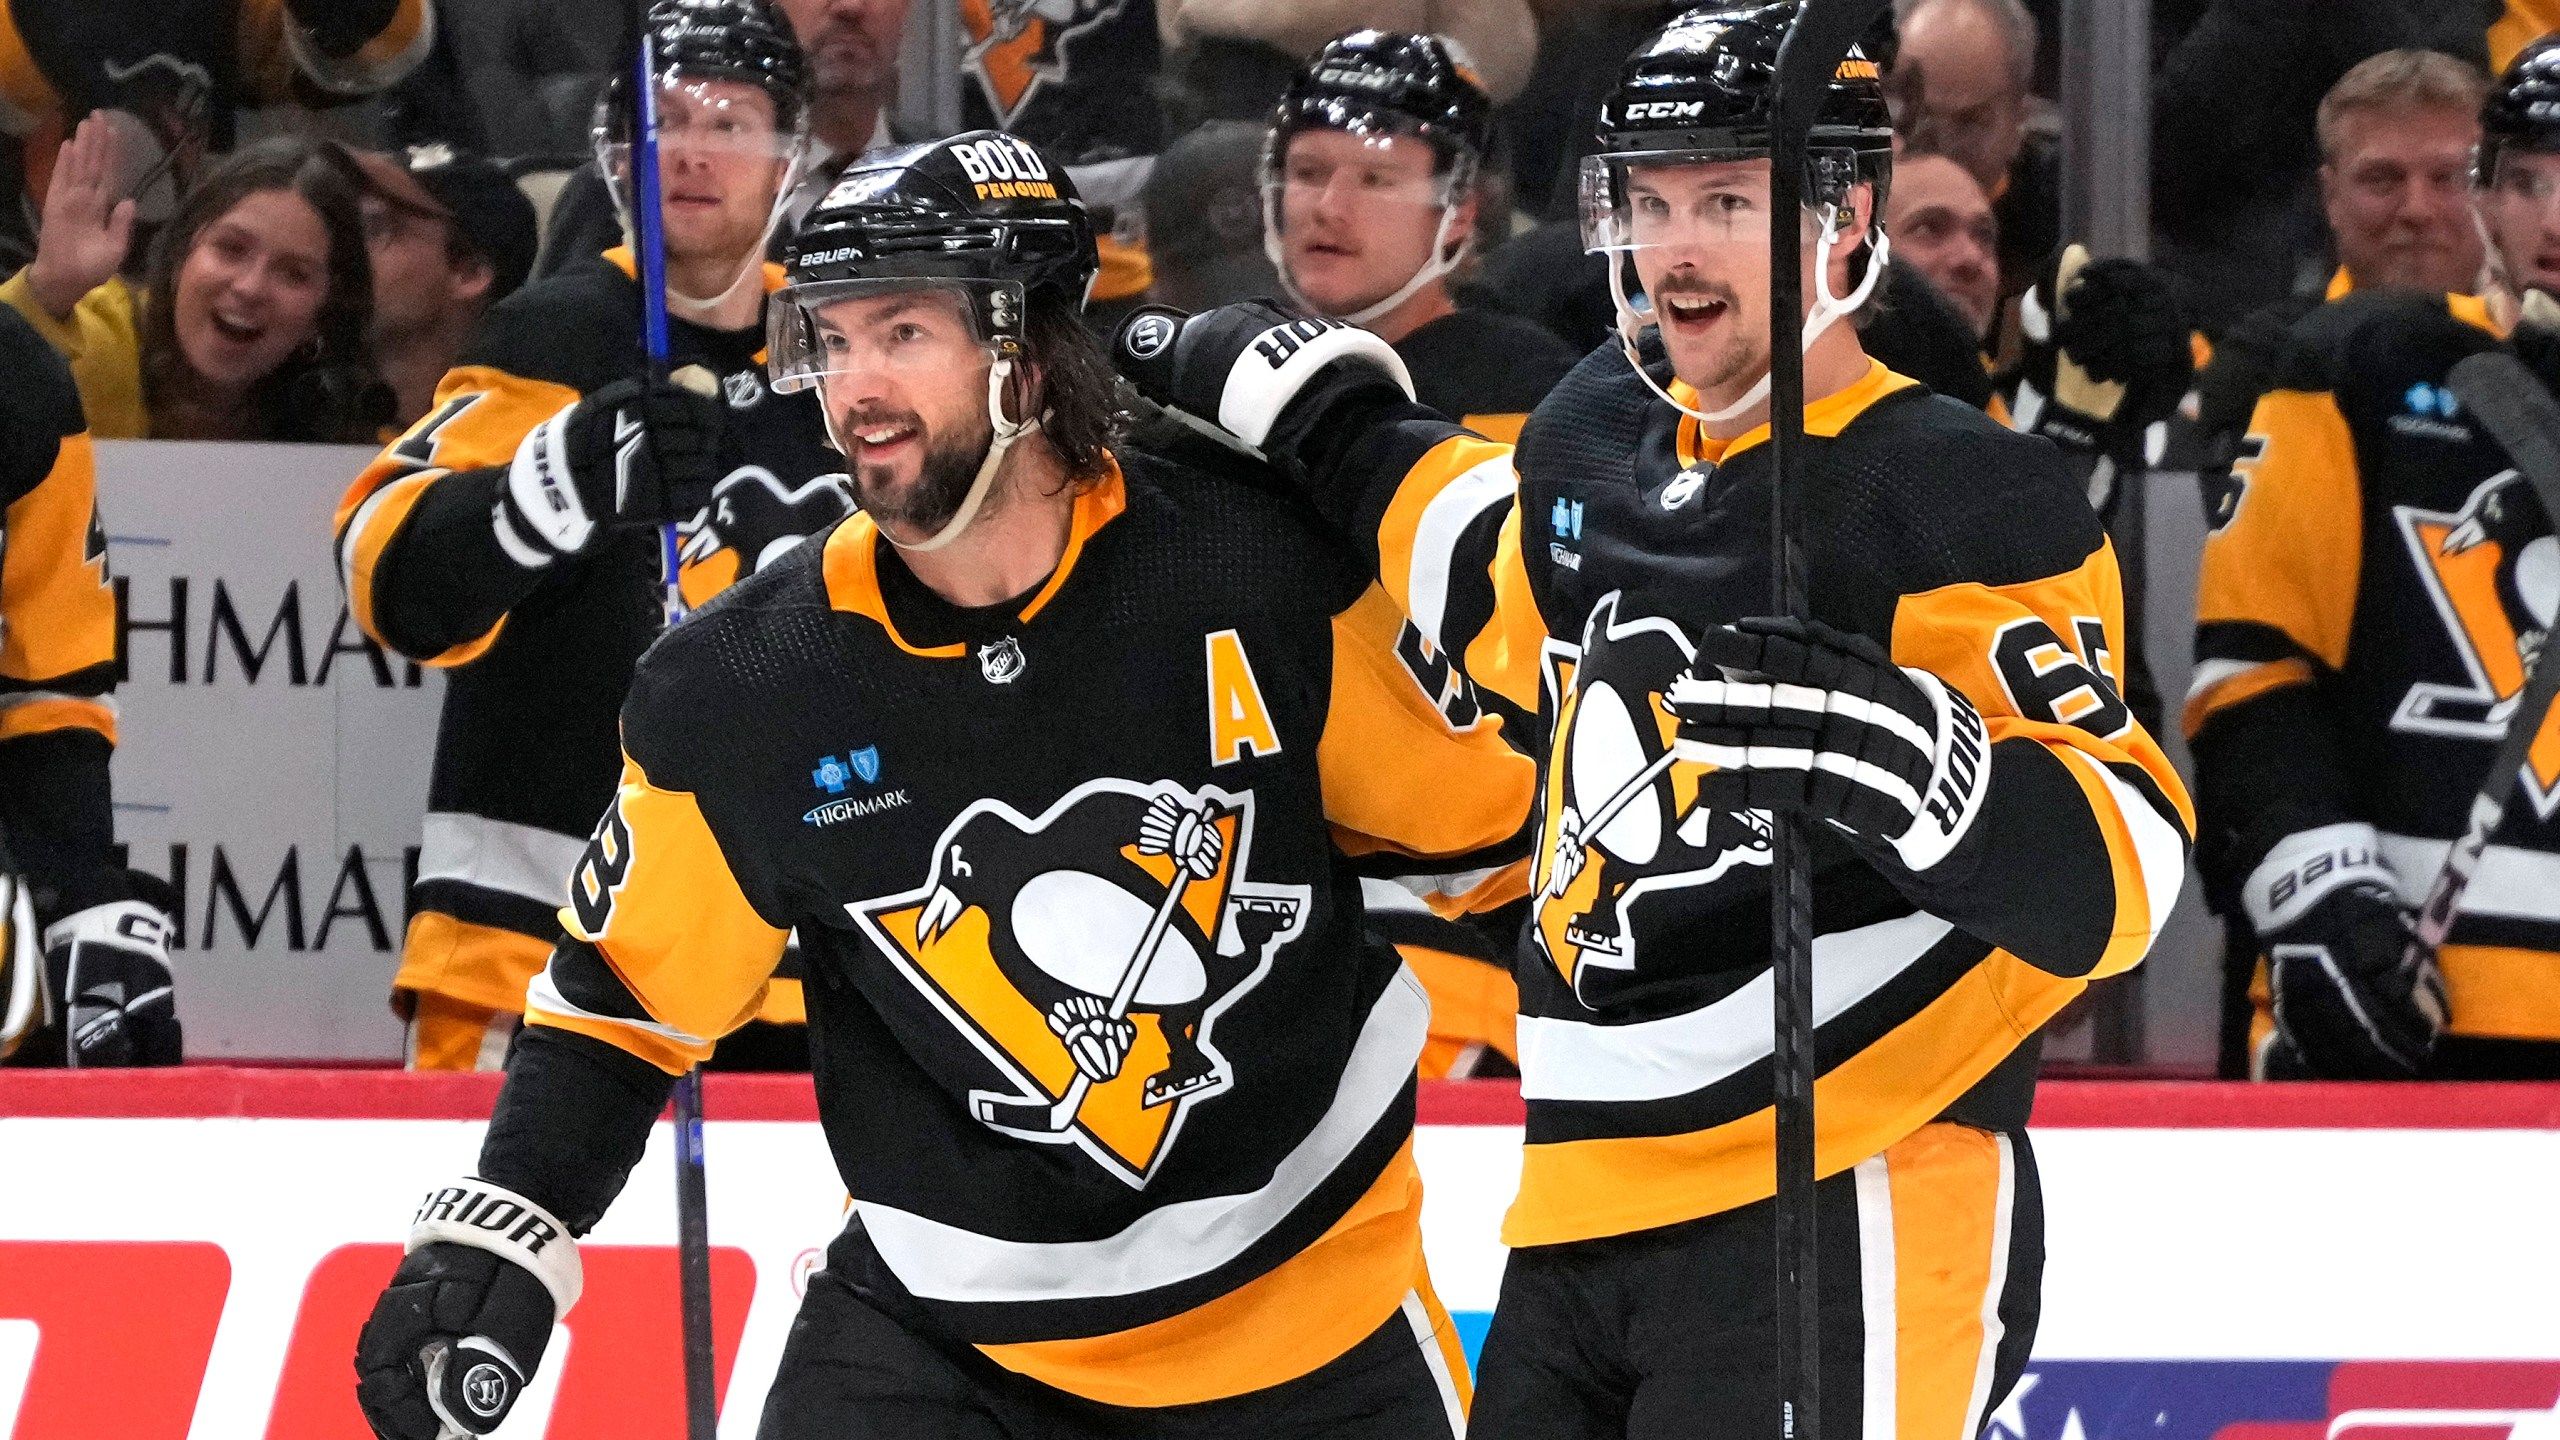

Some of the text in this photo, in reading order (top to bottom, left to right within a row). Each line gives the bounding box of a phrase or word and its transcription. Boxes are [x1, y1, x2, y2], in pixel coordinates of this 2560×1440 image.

[1625, 101, 1705, 120] CCM
[949, 138, 1049, 183] BOLD
[974, 181, 1058, 200] PENGUIN
[1207, 628, 1282, 767] A
[1926, 690, 1982, 837] RIOR
[813, 788, 909, 828] HIGHMARK
[569, 790, 636, 940] 8
